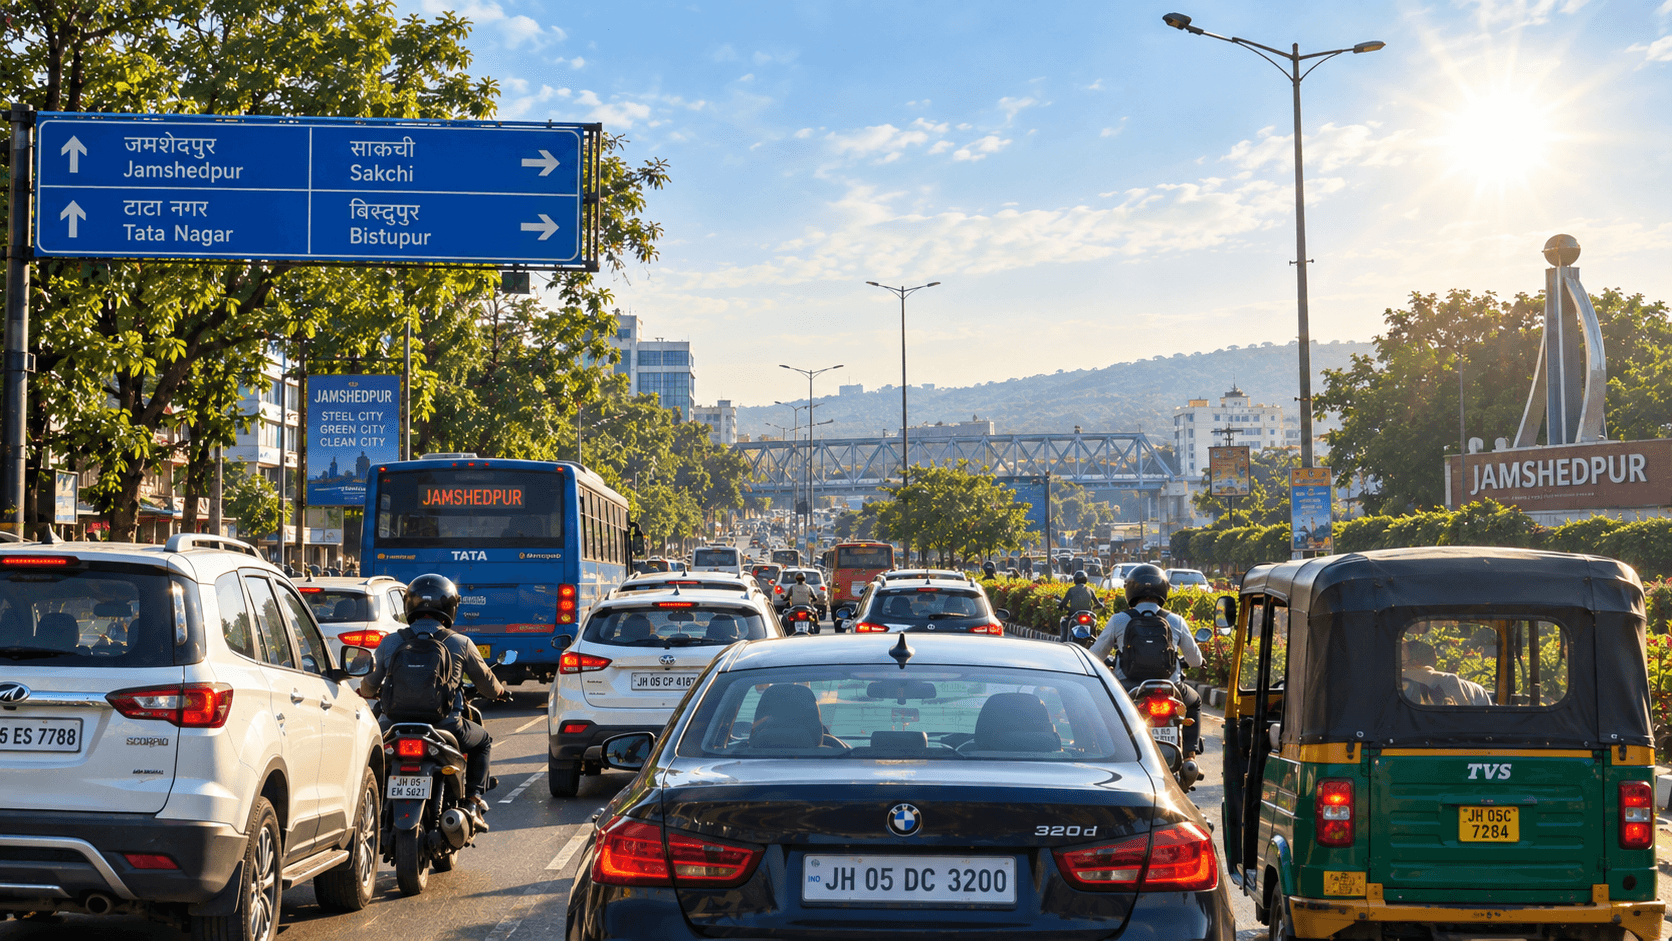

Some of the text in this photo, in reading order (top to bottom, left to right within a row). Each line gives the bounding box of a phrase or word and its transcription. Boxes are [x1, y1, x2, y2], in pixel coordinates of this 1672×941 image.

[124, 131, 217, 159] जमशेदपुर
[349, 136, 416, 158] साकची
[123, 160, 244, 183] Jamshedpur
[350, 164, 413, 182] Sakchi
[123, 199, 209, 217] टाटा नगर
[123, 223, 234, 247] Tata Nagar
[350, 227, 432, 249] Bistupur
[314, 389, 392, 403] JAMSHEDPUR
[321, 411, 384, 422] STEEL CITY
[320, 424, 386, 434] GREEN CITY
[320, 437, 386, 447] CLEAN CITY
[1470, 453, 1647, 496] JAMSHEDPUR
[422, 489, 522, 506] JAMSHEDPUR
[451, 550, 488, 561] TATA
[637, 676, 648, 687] JH
[662, 676, 674, 687] CP
[13, 727, 33, 745] ES
[37, 728, 76, 746] 7788
[1467, 763, 1513, 780] TVS
[396, 777, 408, 787] JH
[1467, 808, 1512, 823] JH 05C
[1034, 825, 1098, 837] 320d
[1471, 824, 1509, 839] 7284
[825, 867, 1007, 893] JH 05 DC 3200
